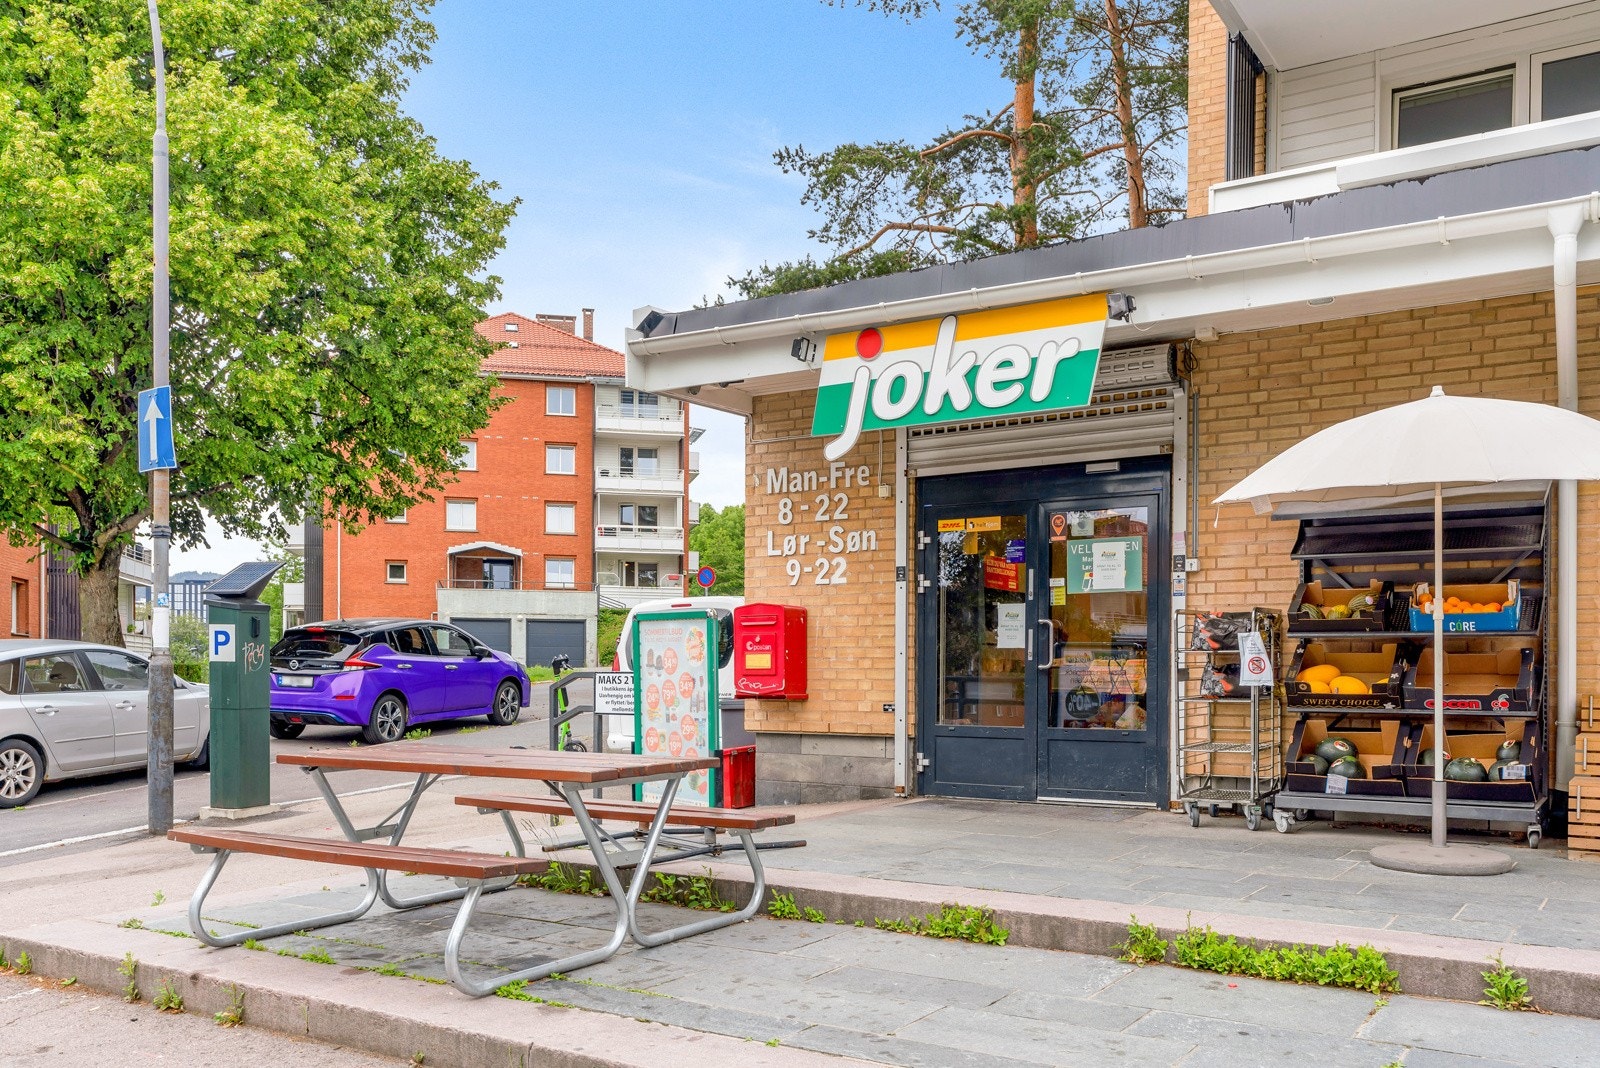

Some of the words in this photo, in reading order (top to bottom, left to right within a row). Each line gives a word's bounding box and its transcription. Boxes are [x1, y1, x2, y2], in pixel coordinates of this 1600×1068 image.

[824, 314, 1081, 461] joker
[767, 461, 870, 494] Man-Fre
[214, 630, 231, 655] P
[598, 675, 622, 685] MAKS
[624, 676, 629, 684] 2
[1303, 698, 1338, 706] SWEET
[1340, 698, 1380, 706] CHOICE
